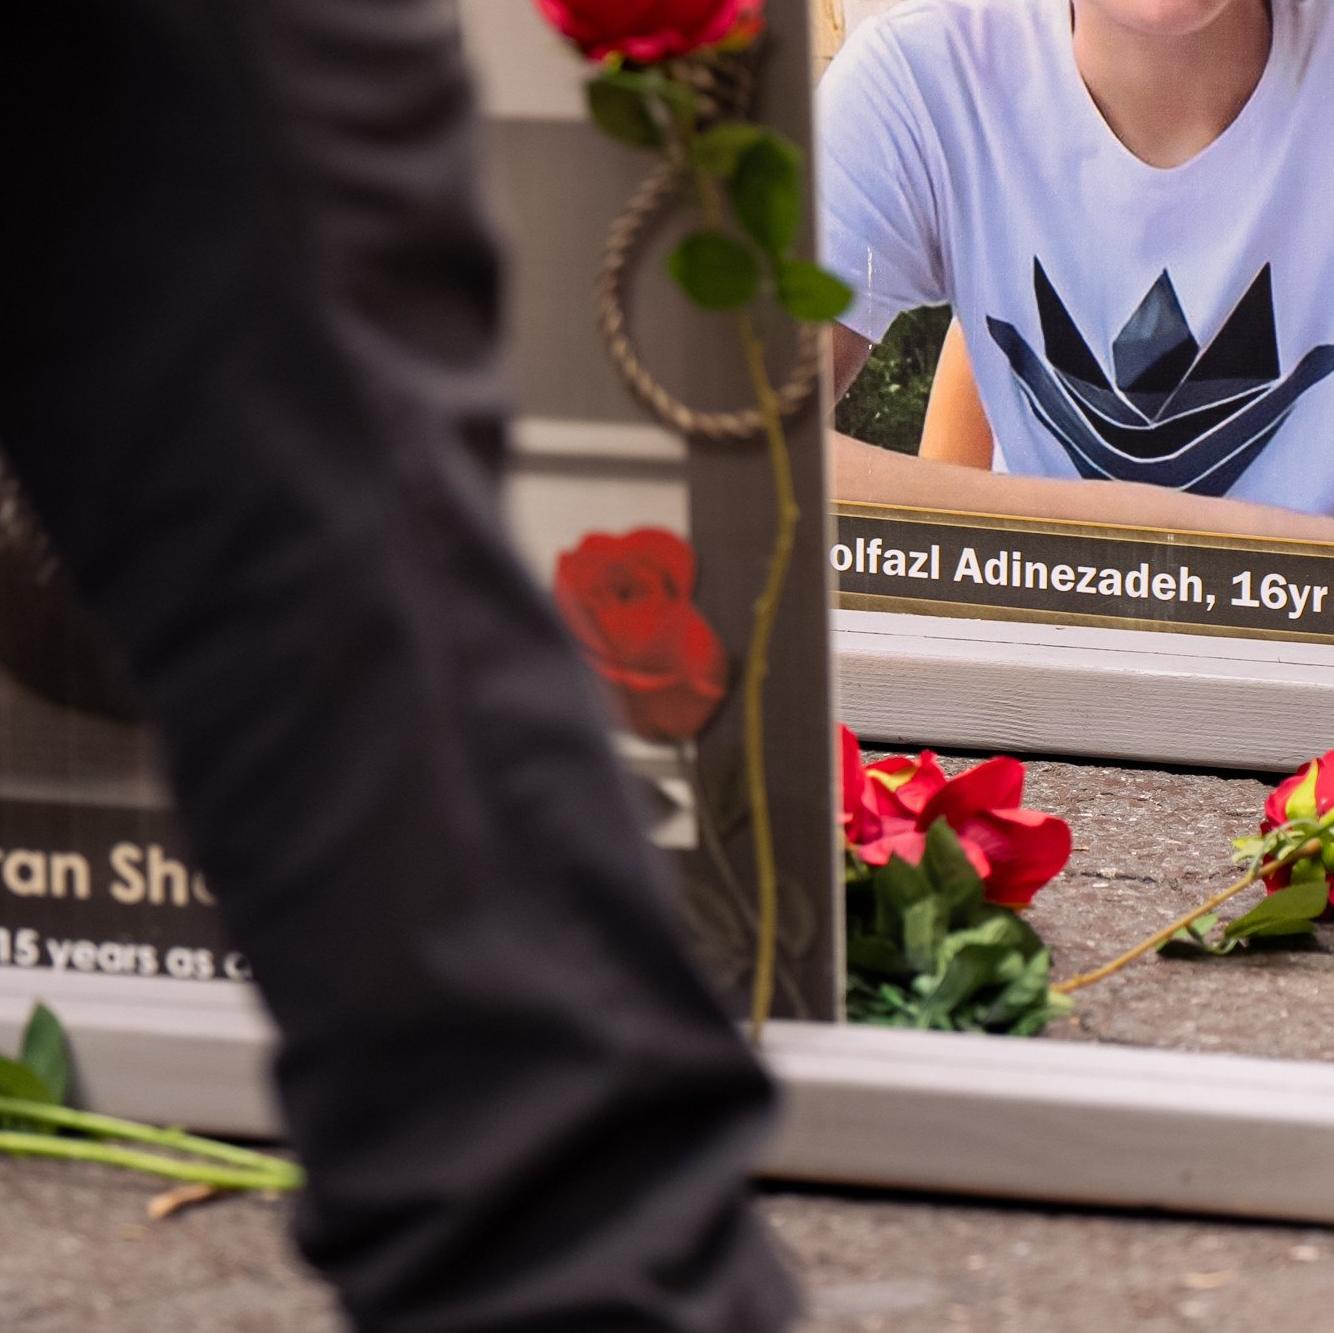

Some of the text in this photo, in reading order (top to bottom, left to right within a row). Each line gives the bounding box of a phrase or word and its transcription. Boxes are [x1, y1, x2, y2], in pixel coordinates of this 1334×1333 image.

[953, 547, 1216, 612] Adinezadeh,
[1230, 570, 1329, 620] 16yr
[47, 936, 159, 978] years
[165, 946, 214, 980] as
